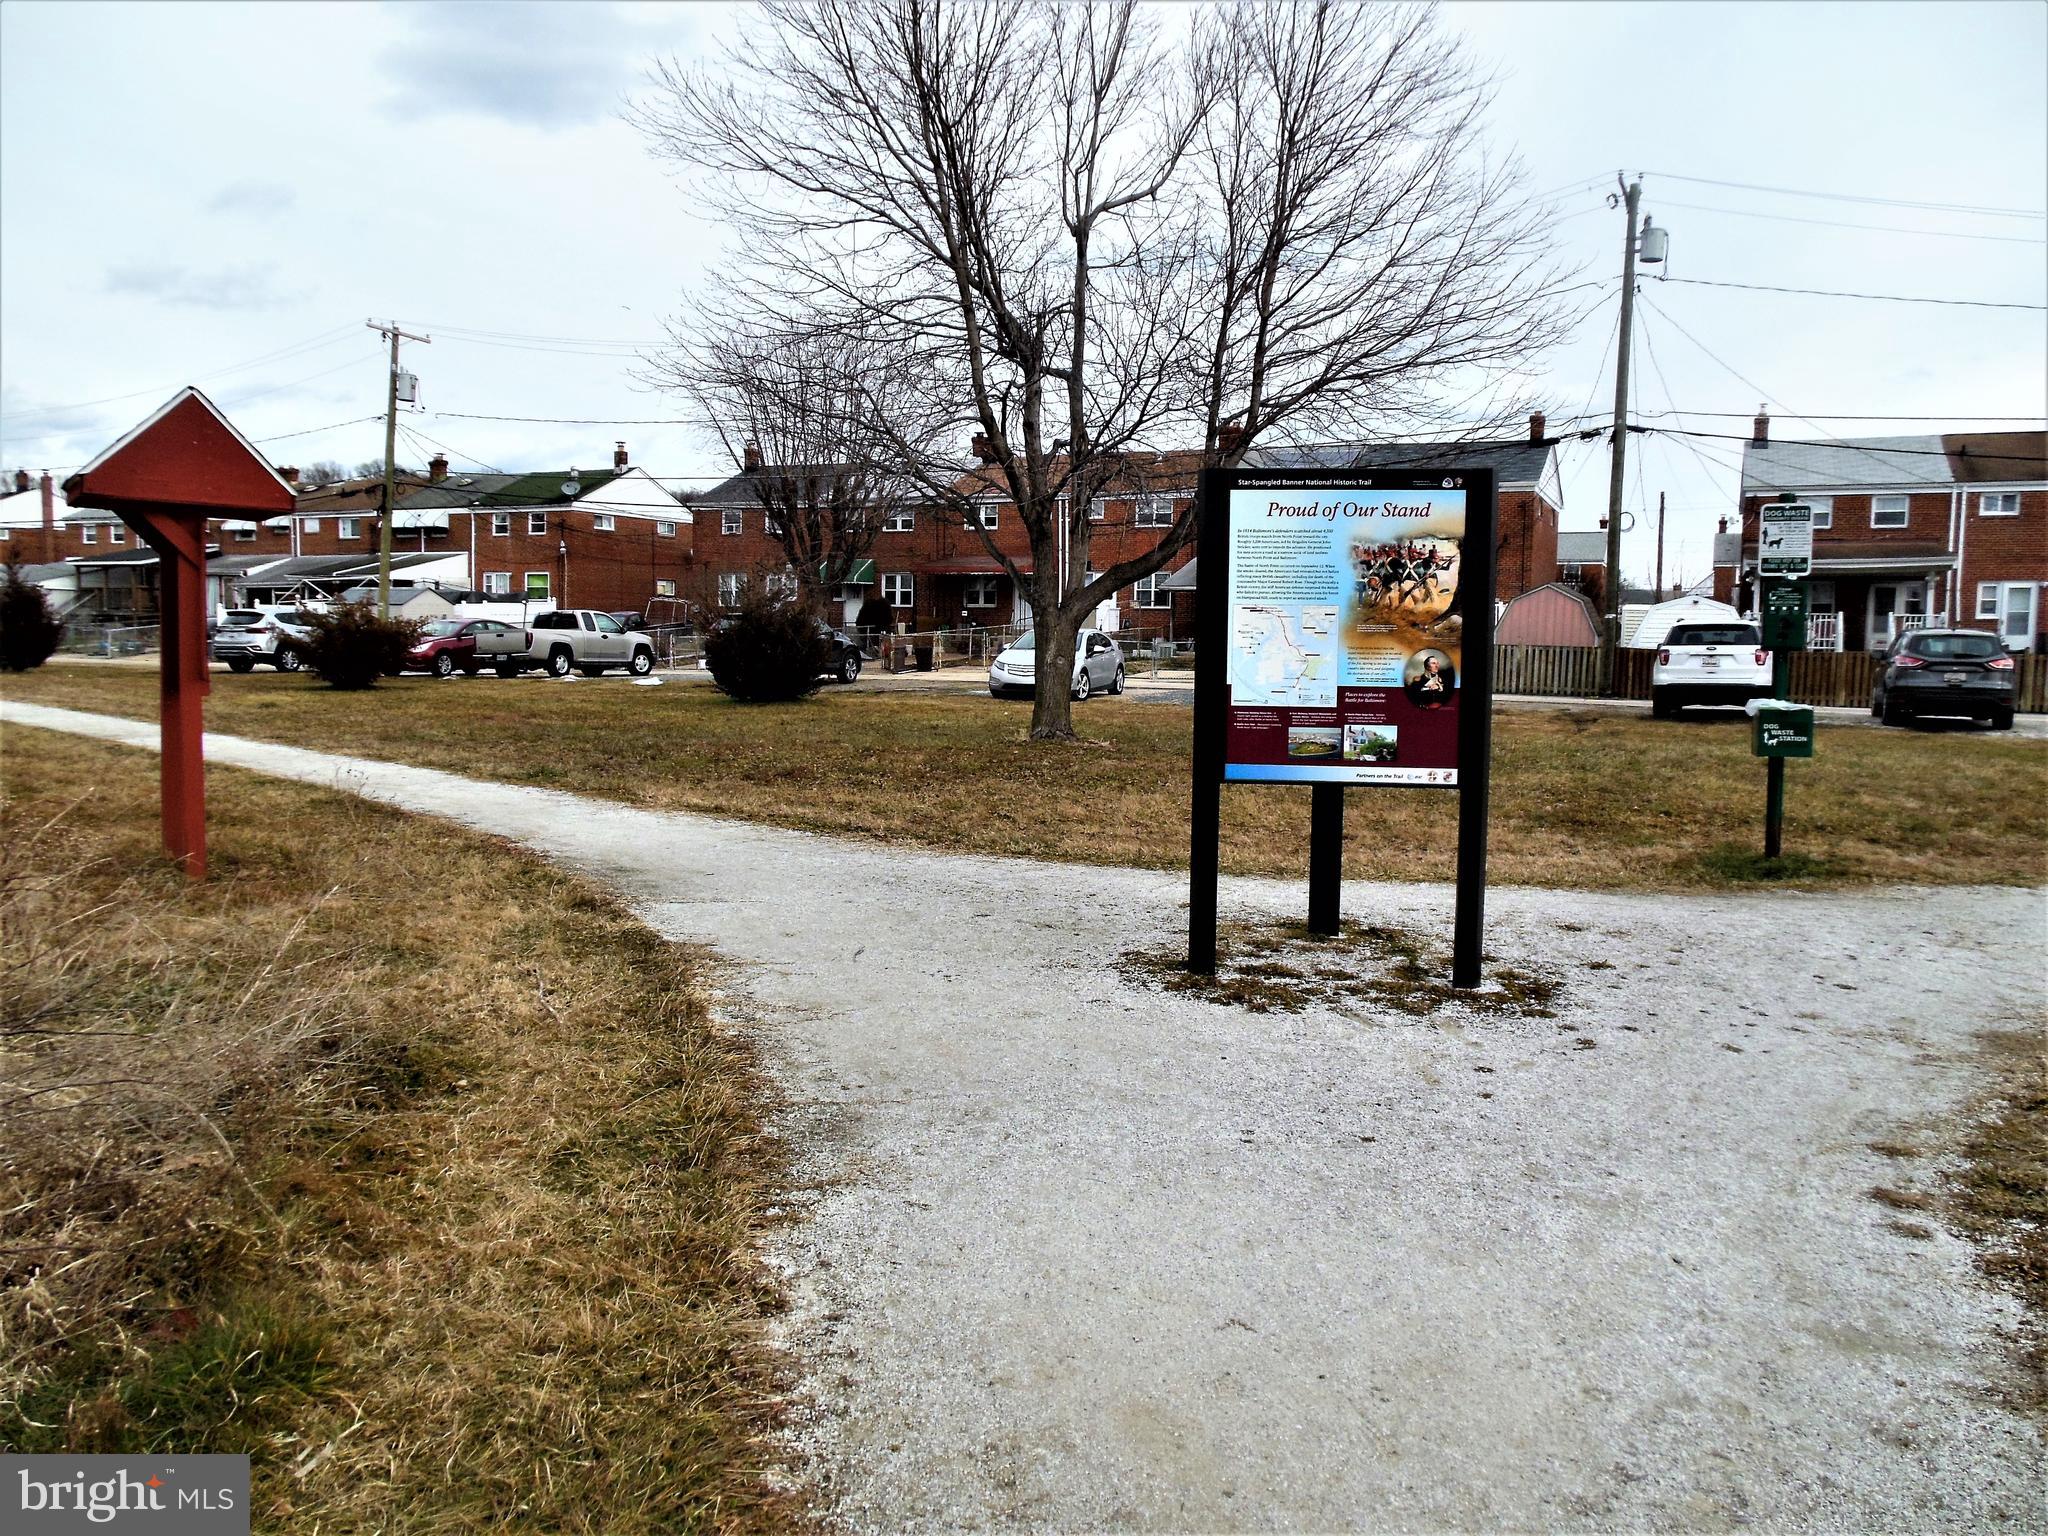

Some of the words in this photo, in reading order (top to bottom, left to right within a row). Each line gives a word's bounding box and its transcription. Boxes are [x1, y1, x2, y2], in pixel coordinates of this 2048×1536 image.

[1266, 502, 1318, 518] Proud
[1322, 502, 1341, 521] of
[1343, 502, 1378, 518] Our
[1381, 502, 1431, 518] Stand
